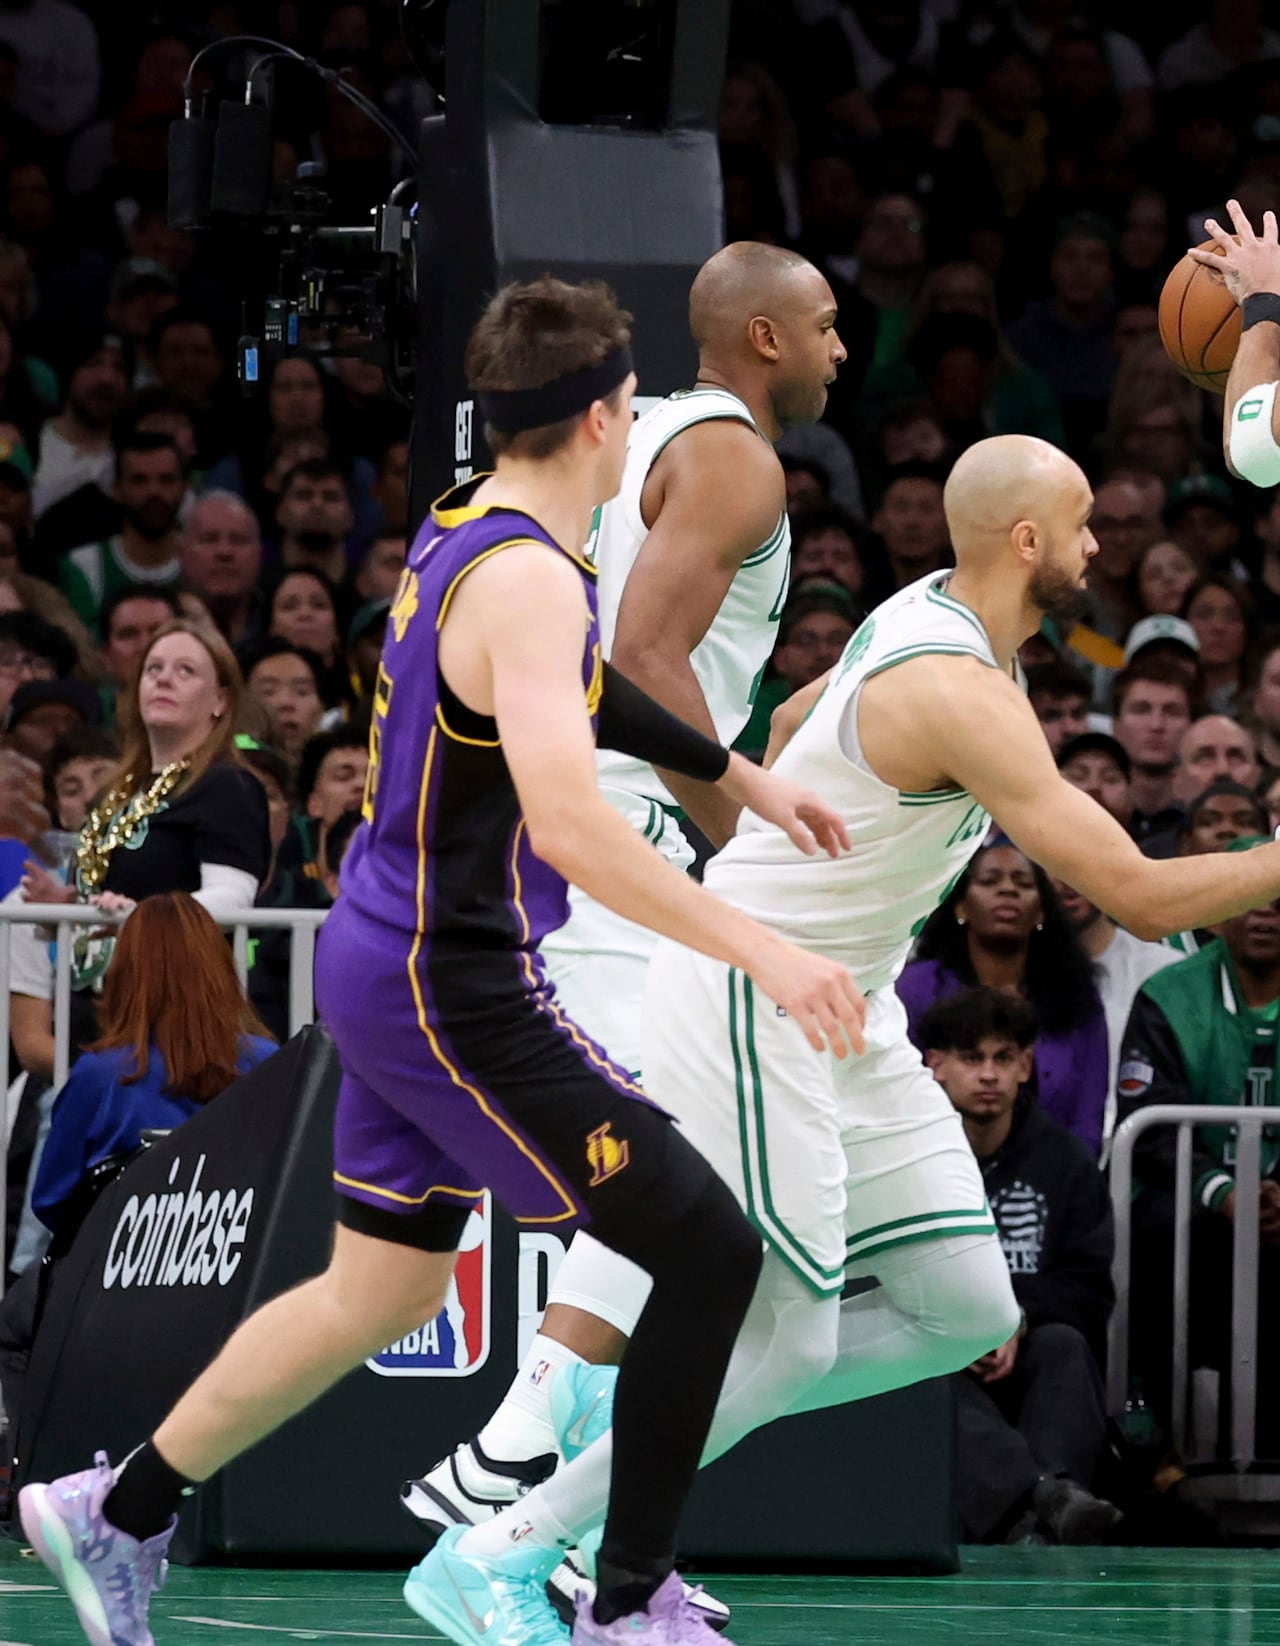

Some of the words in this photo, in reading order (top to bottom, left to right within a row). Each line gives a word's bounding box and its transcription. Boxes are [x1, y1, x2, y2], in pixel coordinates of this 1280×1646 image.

[455, 400, 474, 462] GET
[103, 1153, 254, 1290] coinbase
[381, 1318, 440, 1355] BA
